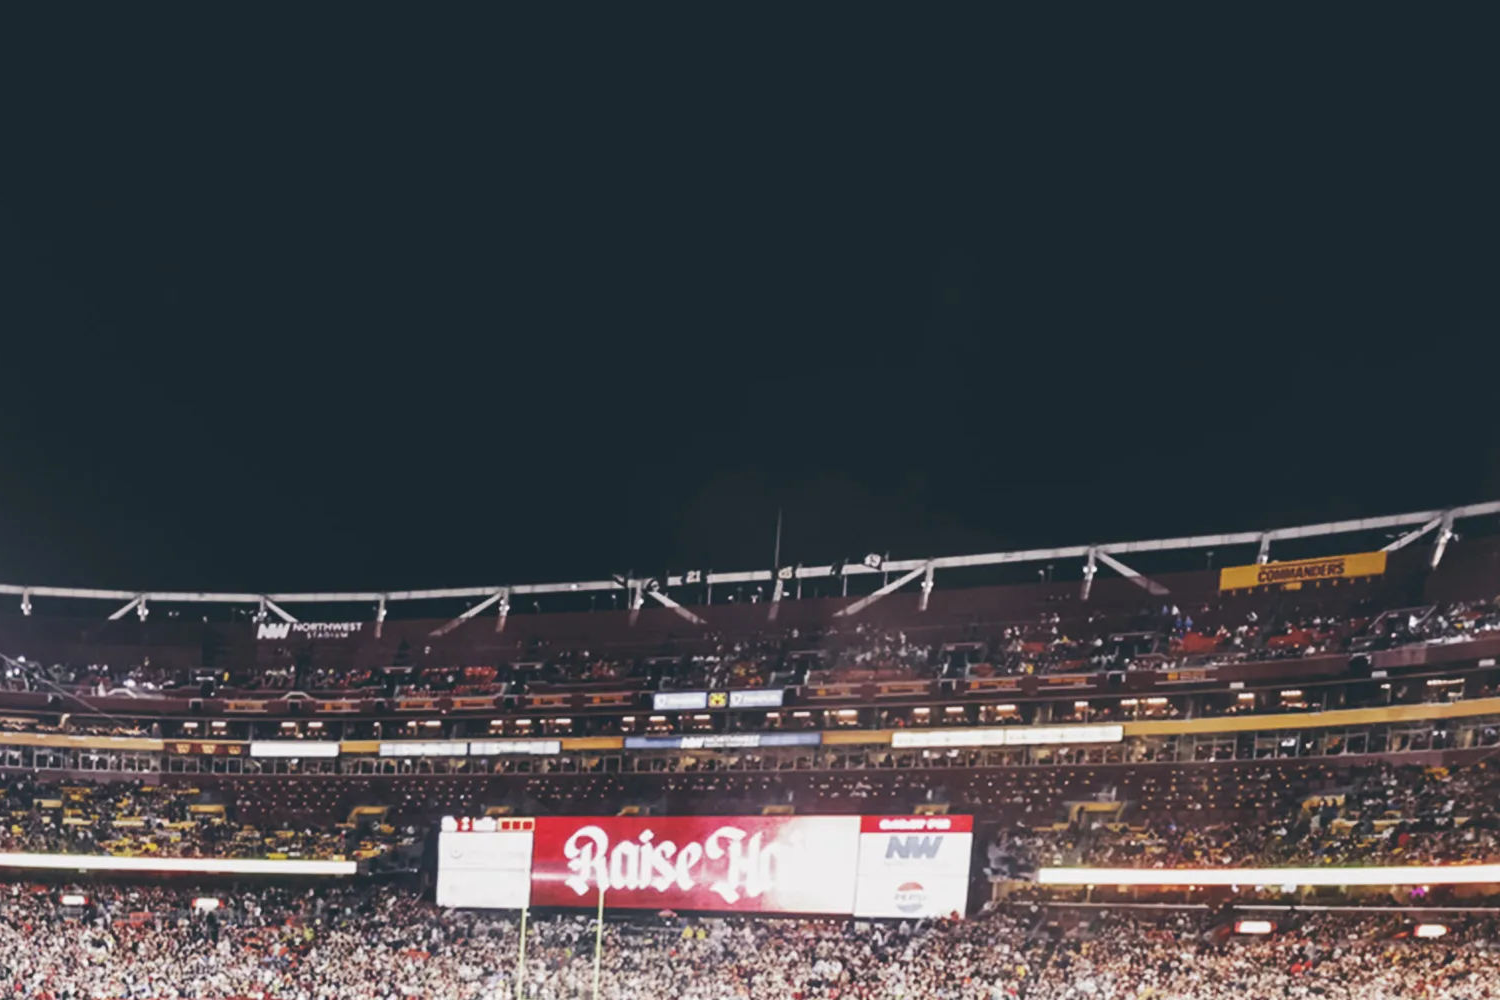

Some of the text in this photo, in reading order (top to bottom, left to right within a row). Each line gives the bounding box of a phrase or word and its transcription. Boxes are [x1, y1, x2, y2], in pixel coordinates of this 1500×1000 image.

[1257, 562, 1345, 583] COMMANDERS
[257, 621, 363, 639] NW NORTHWEST
[884, 835, 944, 859] NW
[563, 825, 702, 896] Raise
